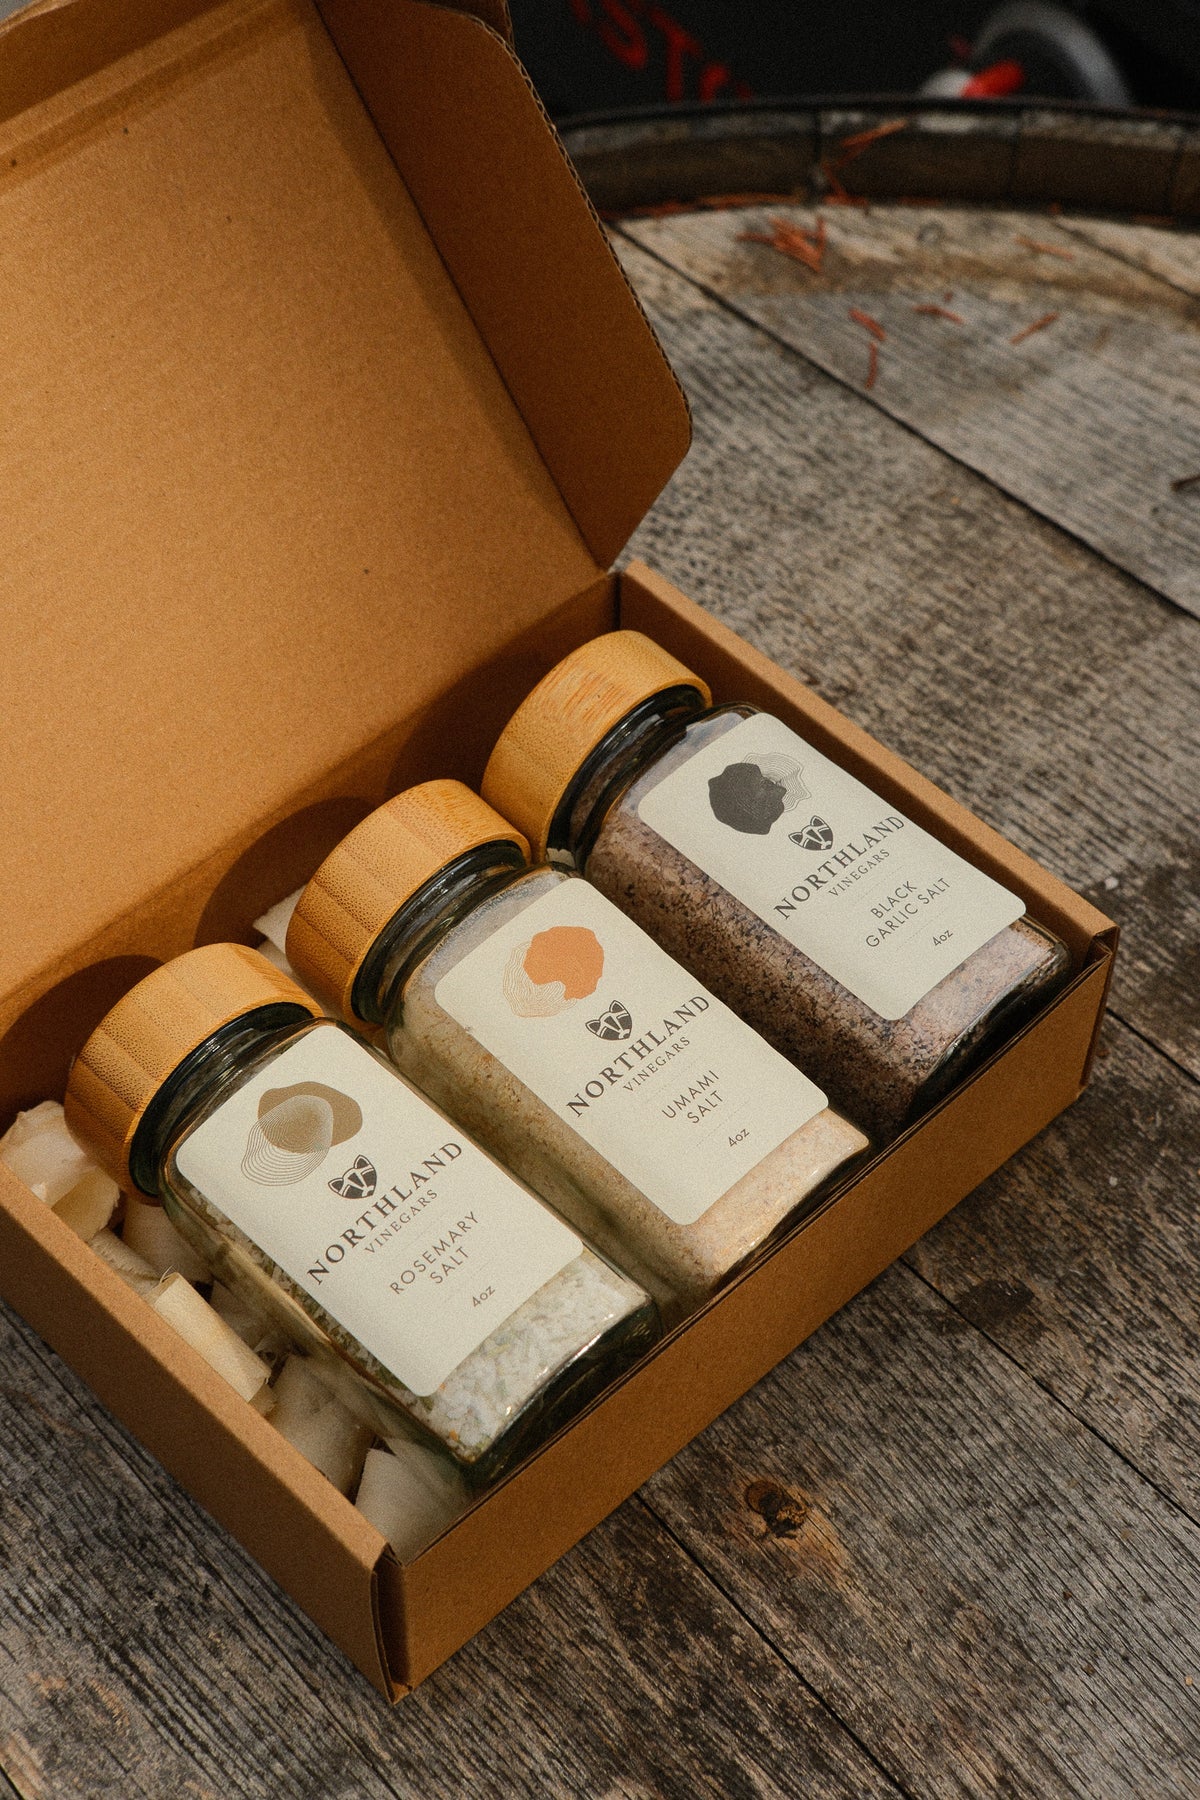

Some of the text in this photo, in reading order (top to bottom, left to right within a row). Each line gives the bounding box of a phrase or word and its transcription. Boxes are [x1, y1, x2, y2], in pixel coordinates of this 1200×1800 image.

[773, 815, 905, 920] NORTHLAND
[828, 848, 891, 897] VINEGARS
[865, 877, 951, 948] GARLIC SALT
[870, 880, 918, 919] BLACK
[932, 929, 954, 947] 4oz
[566, 996, 710, 1118] NORTHLAND
[623, 1036, 691, 1092] VINEGARS
[661, 1069, 720, 1119] UMAMI
[686, 1090, 724, 1124] SALT
[728, 1128, 750, 1148] 4oz
[306, 1142, 463, 1285] NORTHLAND
[364, 1189, 438, 1255] VINEGARS
[389, 1211, 479, 1295] ROSEMARY
[429, 1246, 470, 1284] SALT
[471, 1285, 496, 1308] 4oz
